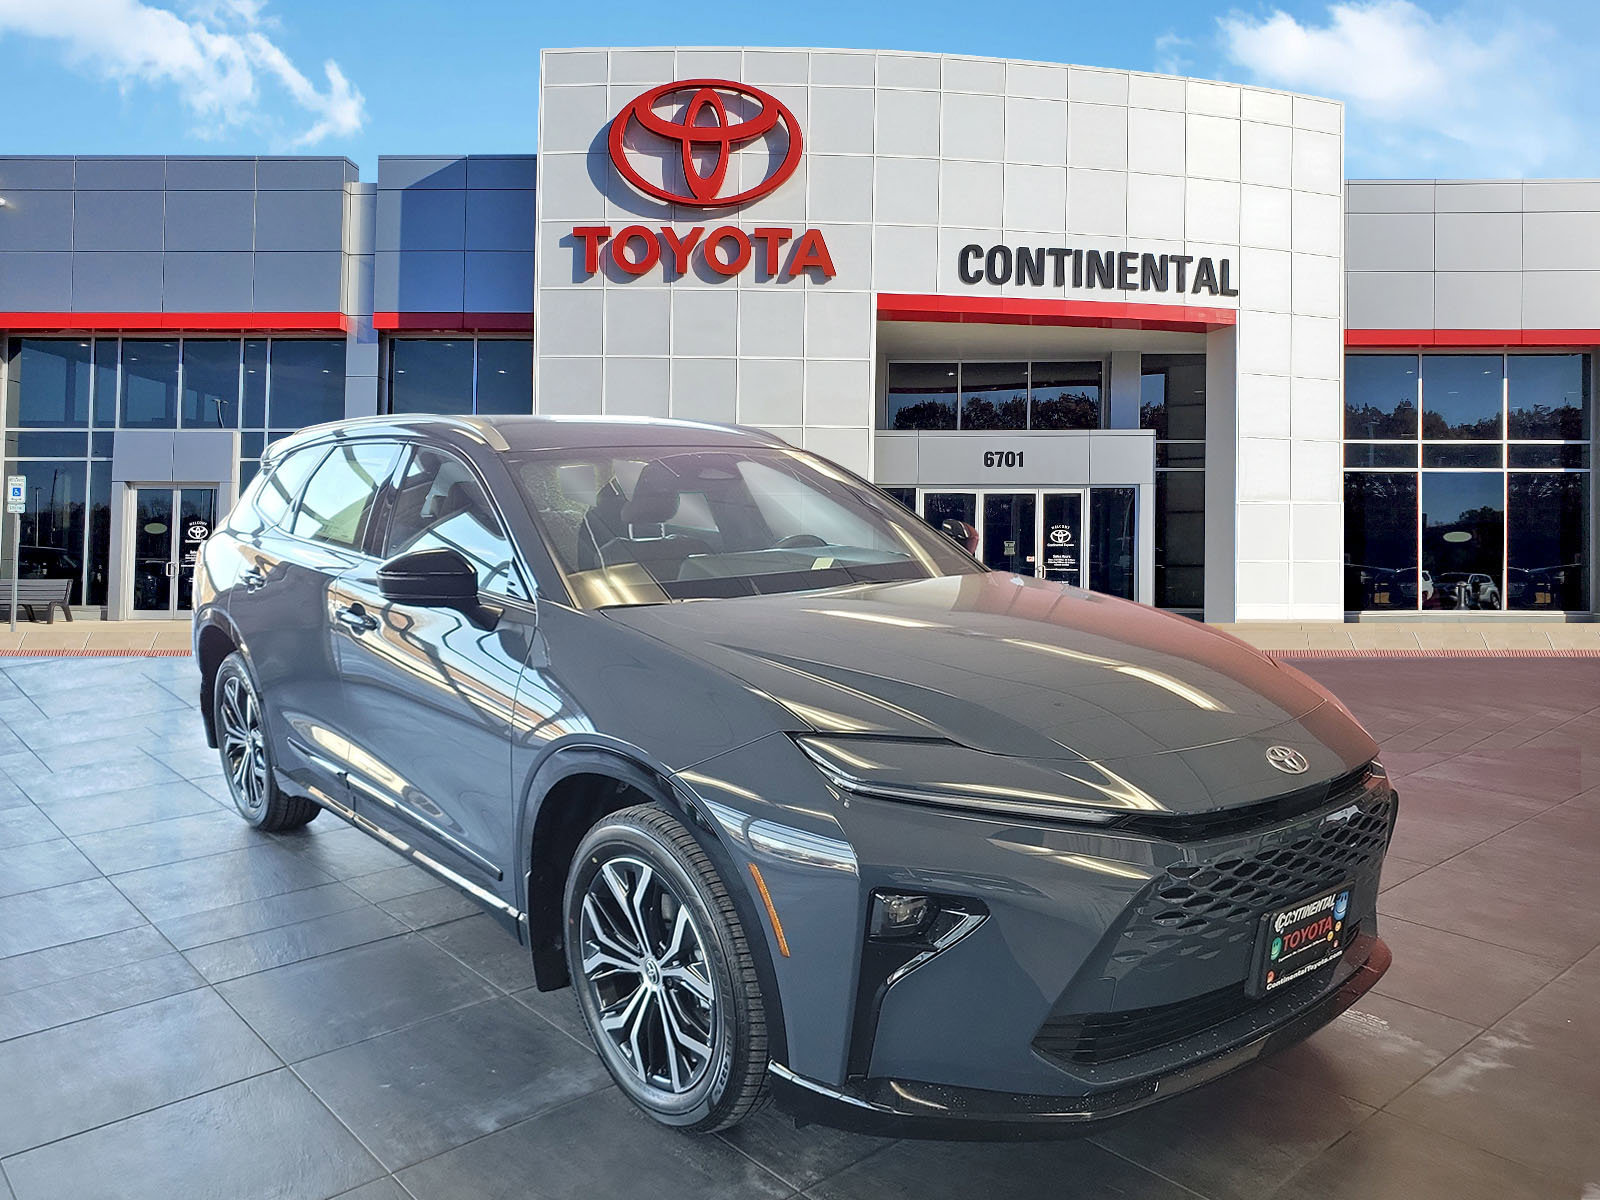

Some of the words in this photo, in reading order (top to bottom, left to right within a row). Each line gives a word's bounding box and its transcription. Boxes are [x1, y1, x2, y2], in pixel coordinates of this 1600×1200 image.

[573, 226, 836, 279] TOYOTA
[958, 243, 1239, 297] CONTINENTAL
[984, 451, 1024, 468] 6701
[1274, 893, 1337, 933] CONTINENTAL
[1283, 916, 1333, 952] TOYOTA
[1266, 950, 1343, 991] ContinentalToyota.com
